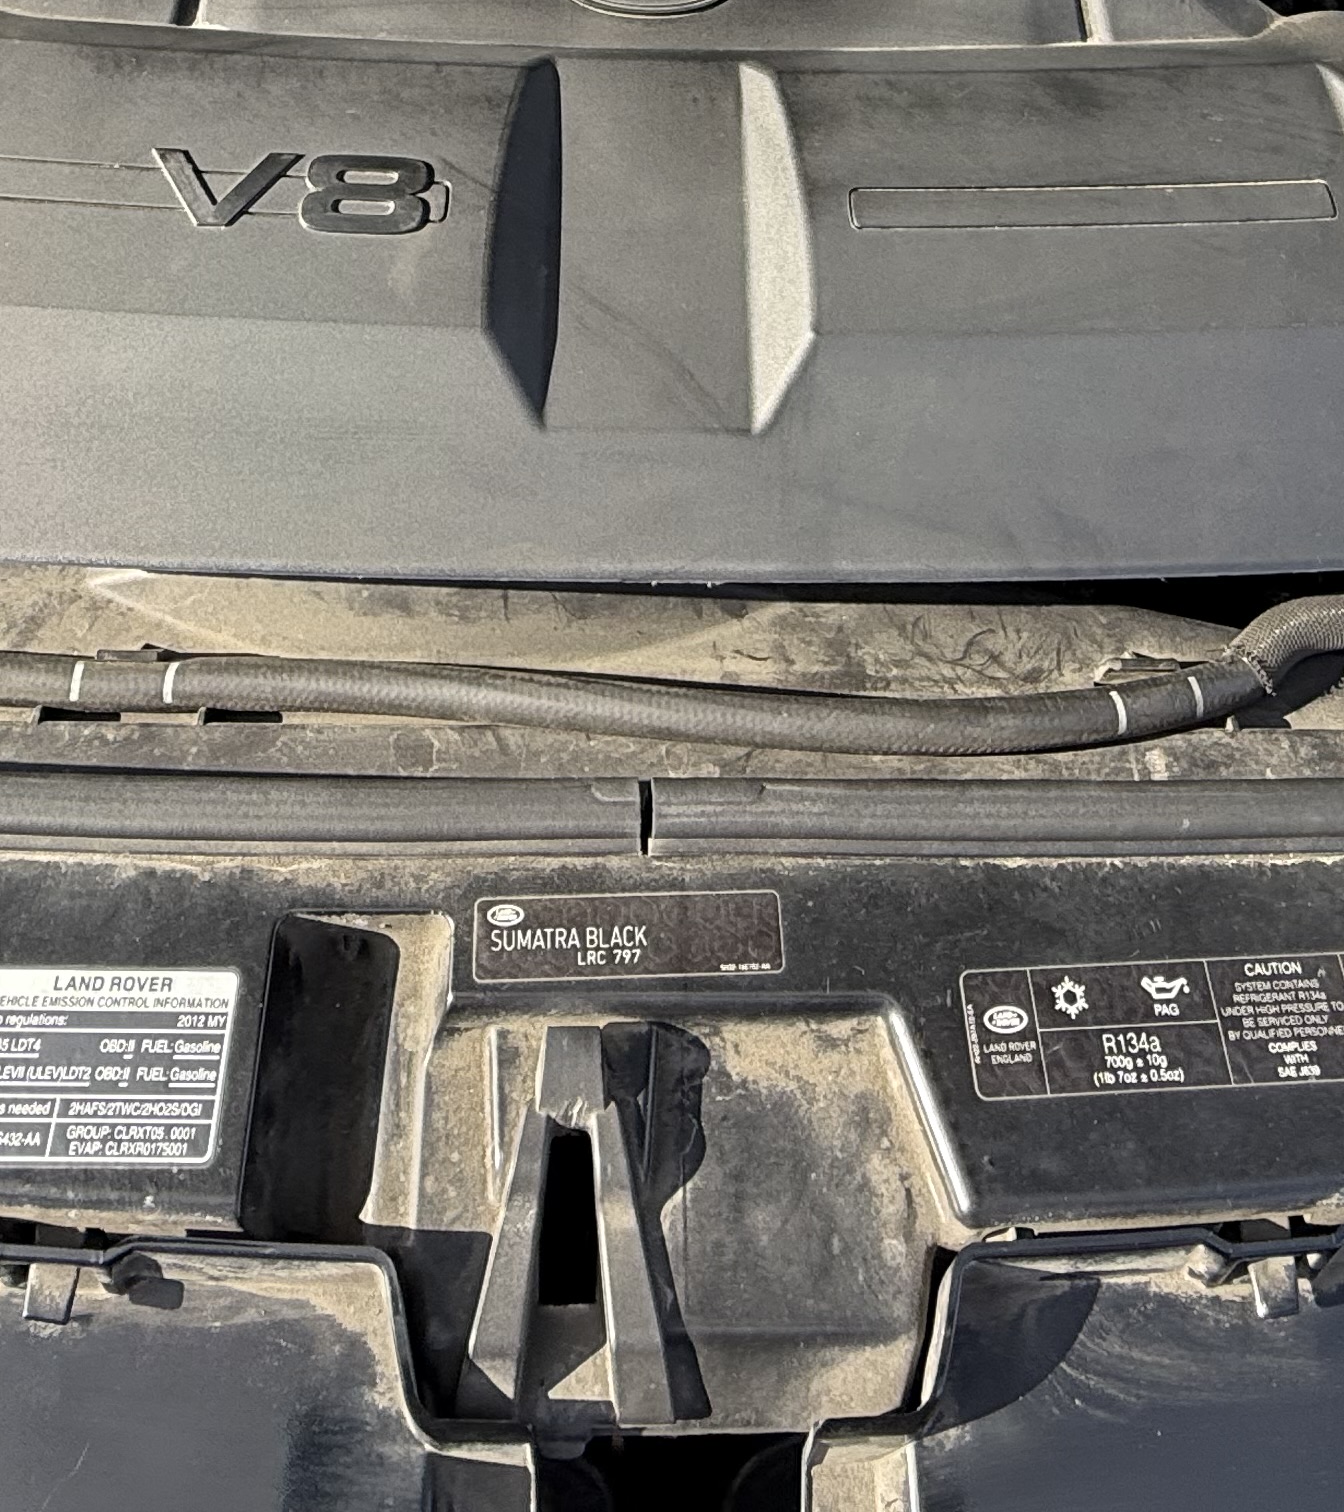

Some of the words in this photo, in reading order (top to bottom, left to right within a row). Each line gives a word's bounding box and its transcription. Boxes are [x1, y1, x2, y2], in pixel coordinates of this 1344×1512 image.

[152, 147, 435, 235] V8
[490, 928, 581, 952] SUMATRA
[586, 925, 648, 948] BLACK
[577, 950, 606, 965] LRC
[612, 949, 641, 965] 797
[1244, 961, 1302, 976] CAUTION
[53, 975, 105, 991] LAND
[109, 976, 173, 992] ROVER
[1234, 981, 1271, 992] SYSTEM
[1272, 979, 1320, 990] CONTAINS
[42, 995, 94, 1007] EMISSION
[97, 996, 149, 1008] CONTROL
[153, 997, 229, 1008] INFORMATION
[1233, 991, 1297, 1004] REFRIGERANT
[1153, 1003, 1180, 1016] PAG
[1220, 1005, 1254, 1017] UNDER
[1255, 1004, 1280, 1015] HIGH
[1281, 1002, 1330, 1014] PRESSURE
[1330, 1001, 1344, 1012] TO
[176, 1014, 206, 1028] 2012
[207, 1015, 227, 1028] MY
[1242, 1017, 1256, 1028] BE
[1256, 1015, 1303, 1027] SERVICED
[1305, 1014, 1329, 1025] ONLY
[1228, 1030, 1241, 1041] BY
[1242, 1028, 1292, 1040] QUALIFIED
[10, 1038, 41, 1051] LDT4
[983, 1042, 1008, 1053] LAND
[1008, 1040, 1037, 1052] ROVER
[1102, 1032, 1162, 1054] R134a
[1268, 1040, 1318, 1053] COMPLIES
[991, 1053, 1033, 1064] ENGLAND
[1104, 1054, 1134, 1070] 700g
[1146, 1053, 1168, 1068] 10g
[1283, 1054, 1310, 1065] WITH
[7, 1101, 51, 1115] needed
[66, 1125, 111, 1139] GROUP:
[68, 1141, 103, 1156] EVAP:
